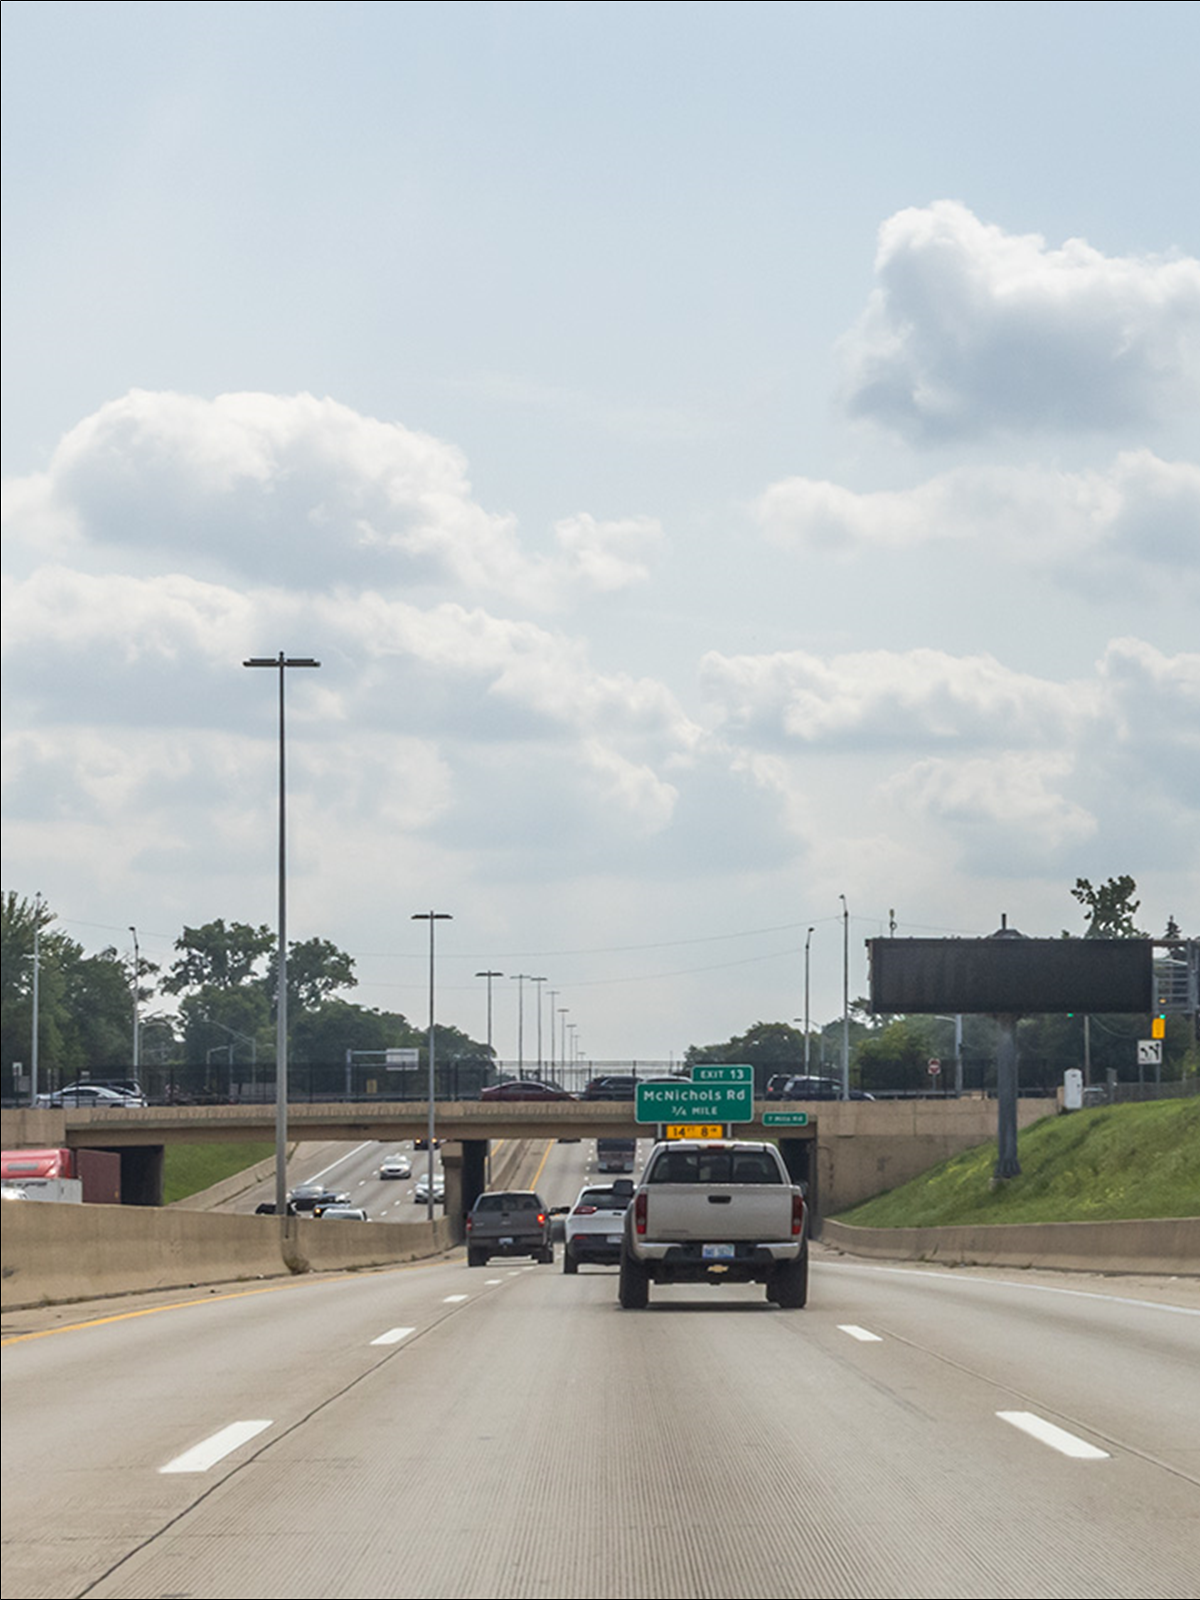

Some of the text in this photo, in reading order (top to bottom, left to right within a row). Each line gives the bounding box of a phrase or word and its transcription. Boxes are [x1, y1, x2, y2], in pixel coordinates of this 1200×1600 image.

[700, 1069, 744, 1079] EXIT 13
[643, 1089, 745, 1101] McNichols Rd
[692, 1106, 718, 1115] MILE
[673, 1127, 685, 1137] 14
[701, 1126, 709, 1137] 8
